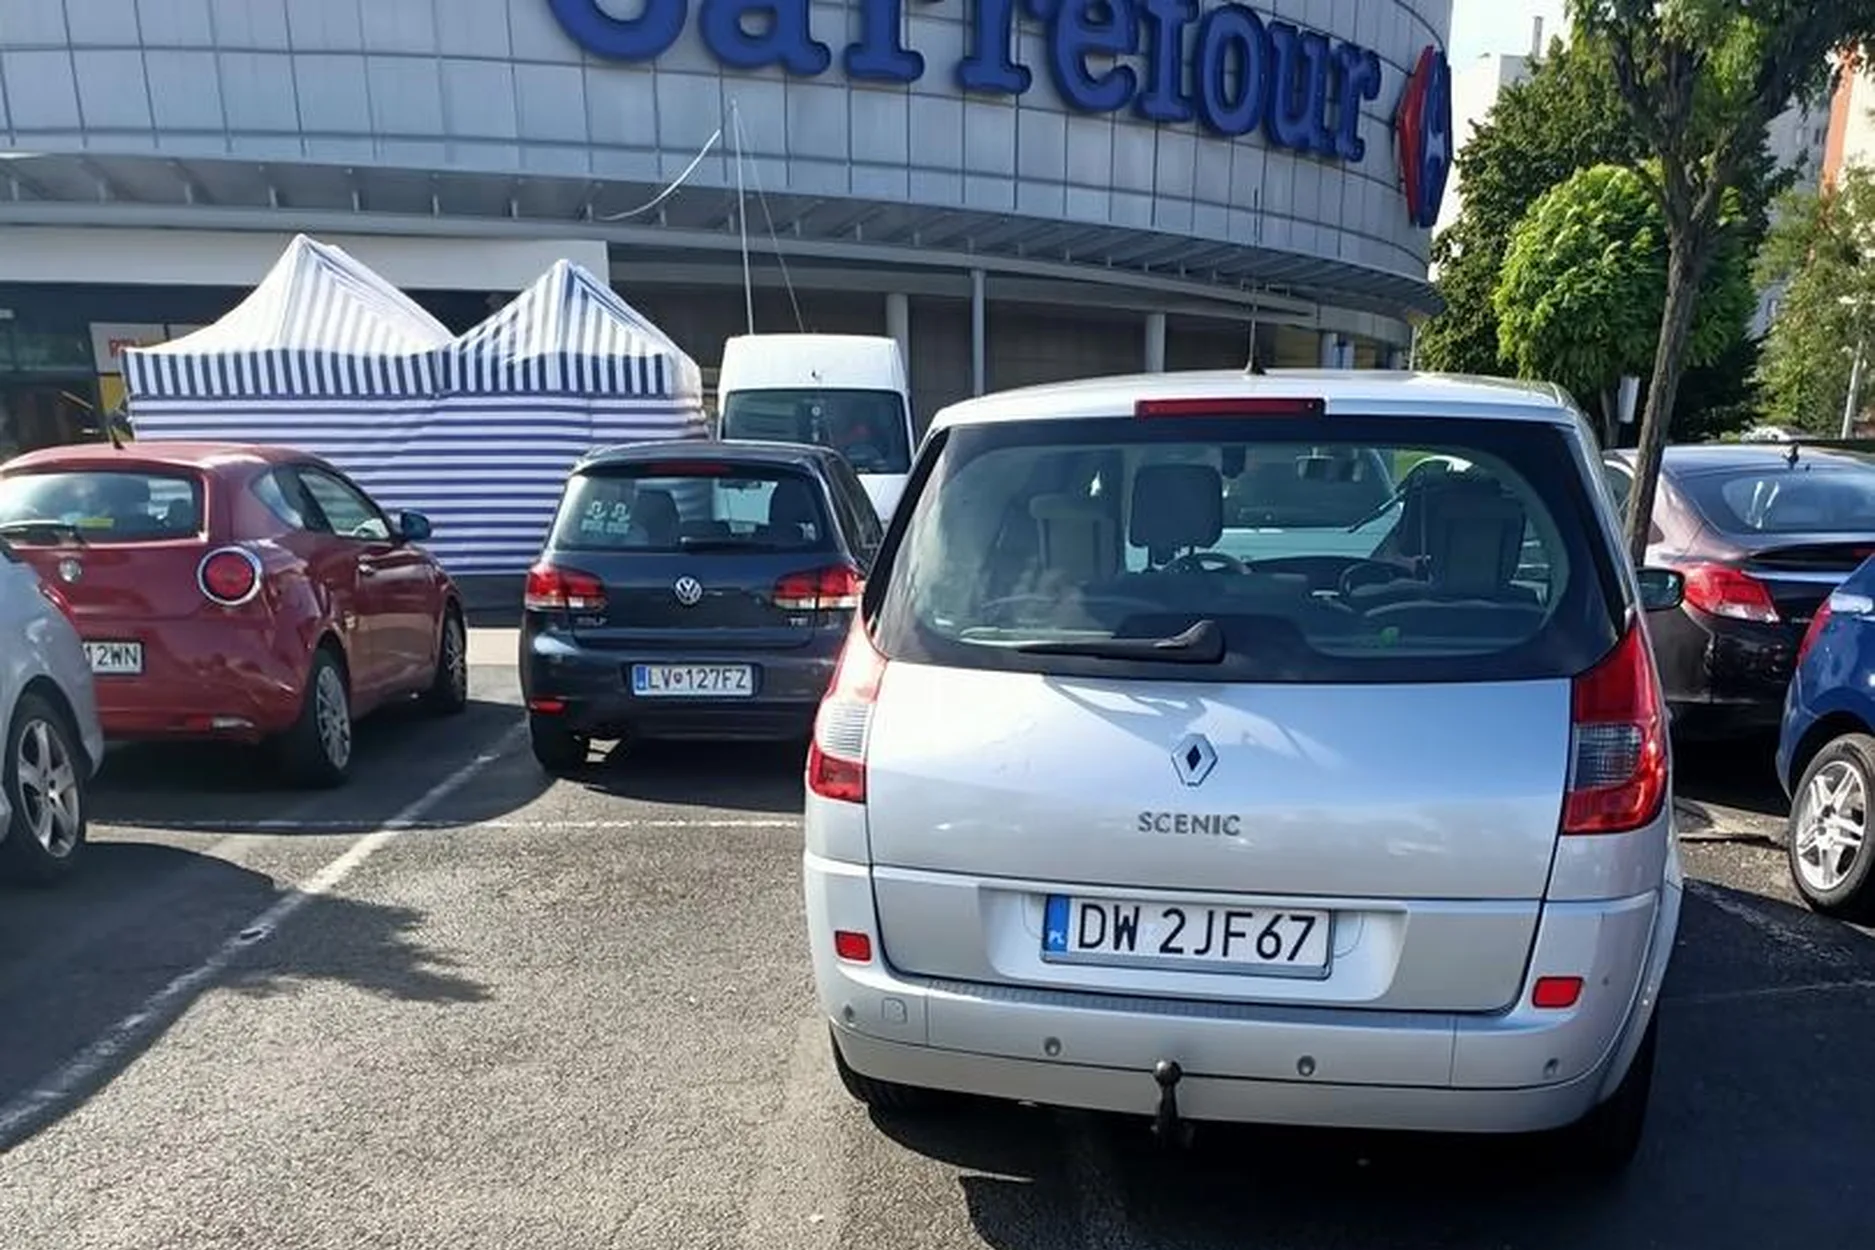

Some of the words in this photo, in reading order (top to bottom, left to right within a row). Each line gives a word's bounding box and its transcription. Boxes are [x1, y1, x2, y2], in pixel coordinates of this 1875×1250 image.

[1138, 811, 1241, 837] SCENIC
[1078, 903, 1140, 951] DW
[1159, 908, 1316, 962] 2JF67
